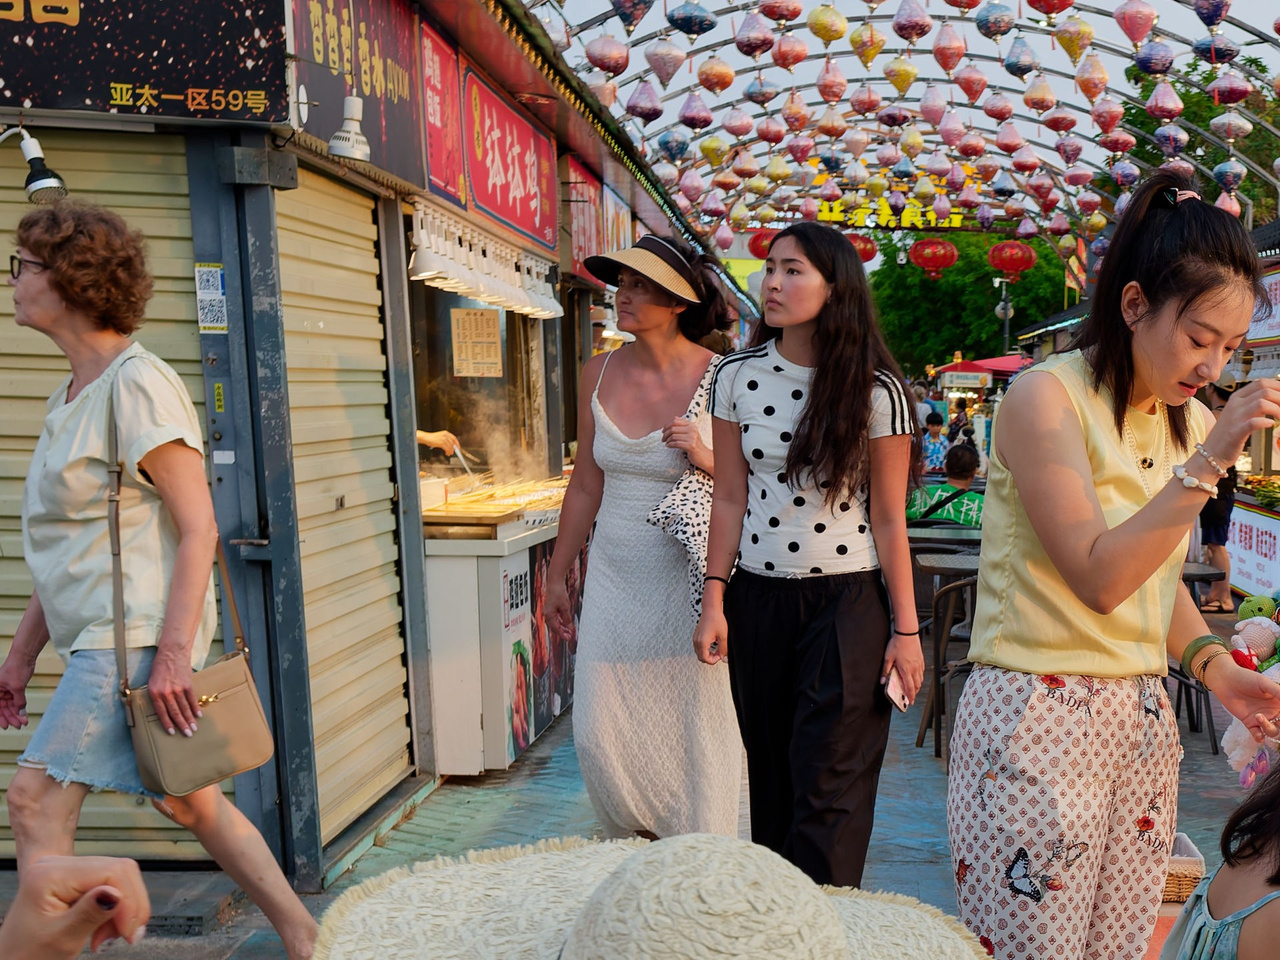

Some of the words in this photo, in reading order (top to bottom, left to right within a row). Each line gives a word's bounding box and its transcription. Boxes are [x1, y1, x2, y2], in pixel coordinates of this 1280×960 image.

[109, 82, 269, 113] 亚太一区59号
[484, 102, 541, 229] 钵钵鸡
